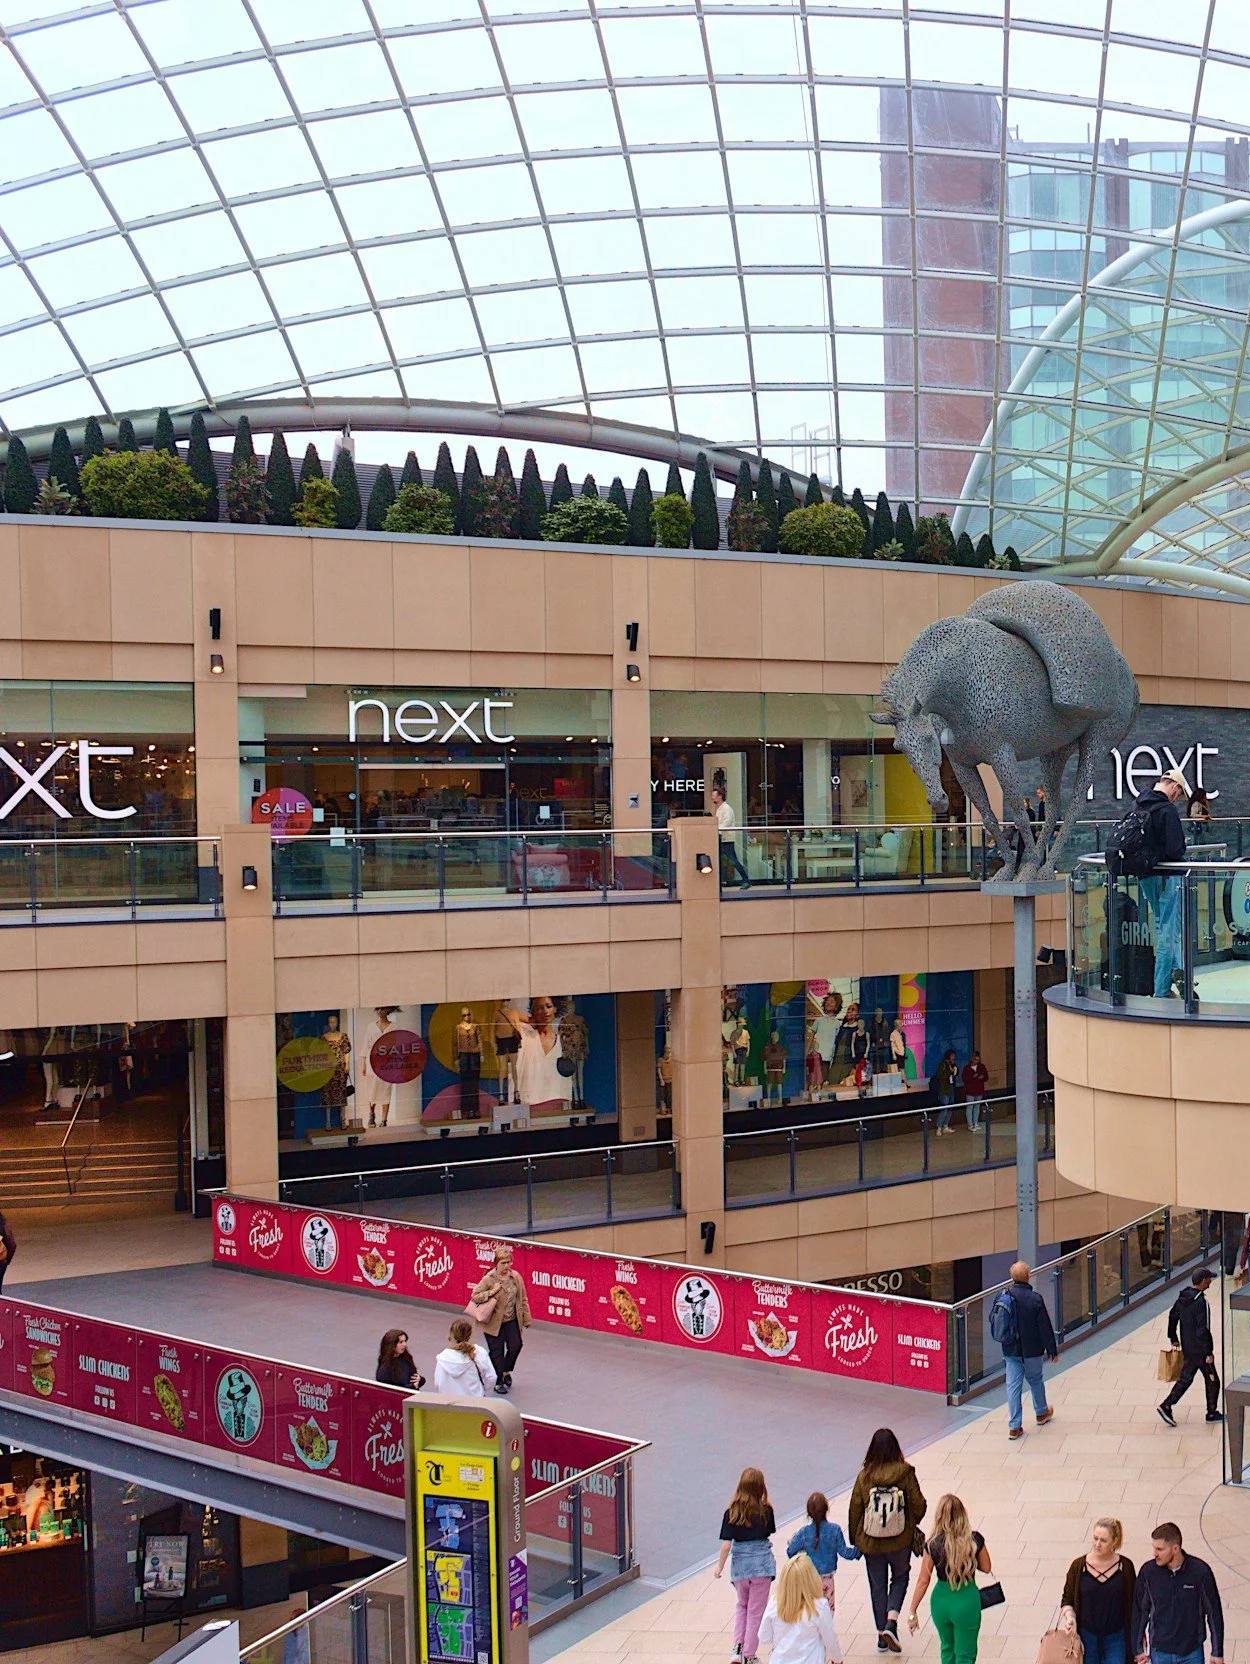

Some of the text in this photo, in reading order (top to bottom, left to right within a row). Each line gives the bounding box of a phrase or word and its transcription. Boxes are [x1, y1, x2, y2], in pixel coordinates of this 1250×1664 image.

[348, 697, 515, 743] next
[0, 739, 137, 819] xt
[664, 779, 705, 792] HERE
[260, 802, 306, 814] SALE
[377, 1042, 421, 1056] SALE
[280, 1062, 332, 1074] REDUCTIONS
[283, 1053, 328, 1065] FURTHER
[249, 1219, 284, 1252] Fresh
[363, 1231, 387, 1244] TENDERS
[414, 1246, 453, 1282] Fresh
[532, 1271, 586, 1293] SLIM CHICKENS
[615, 1269, 637, 1284] WINGS
[752, 1280, 793, 1297] Buttermilk
[757, 1293, 788, 1308] TENDERS
[25, 1328, 61, 1347] SANDWICHES
[825, 1316, 878, 1358] Fresh
[897, 1334, 941, 1351] SLIM CHICKENS
[78, 1354, 130, 1381] SLIM CHICKENS
[159, 1356, 180, 1373] WINGS
[293, 1377, 334, 1398] Buttermilk
[298, 1394, 329, 1413] TENDERS
[365, 1433, 404, 1472] Fres
[531, 1458, 560, 1484] SLIM
[583, 1507, 591, 1518] US
[513, 1504, 521, 1543] Ground
